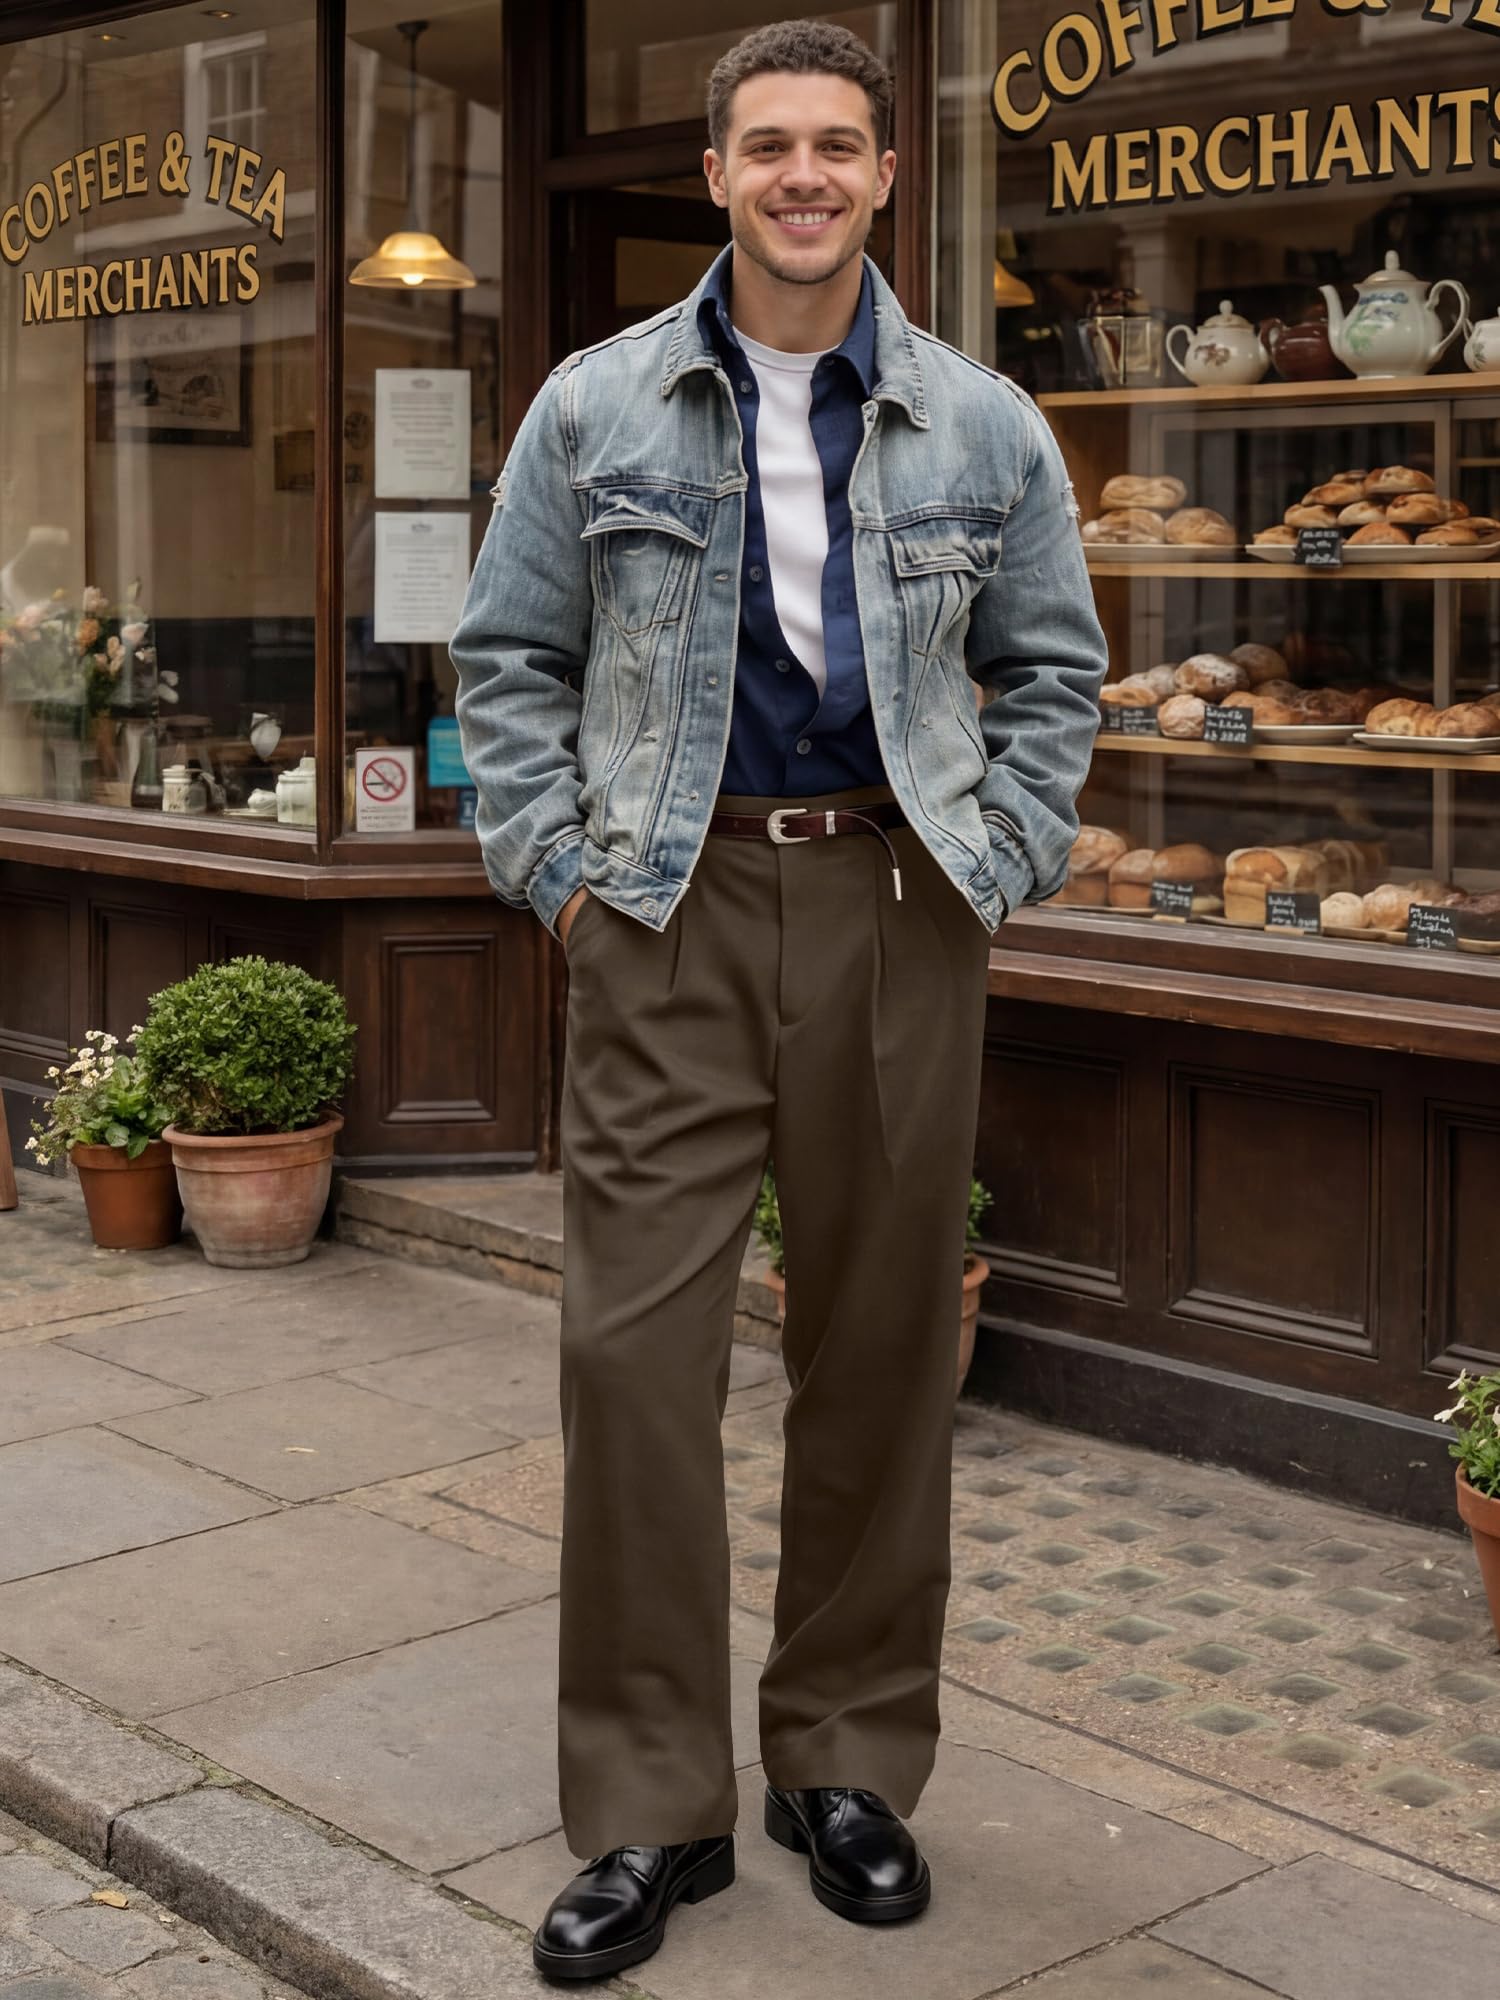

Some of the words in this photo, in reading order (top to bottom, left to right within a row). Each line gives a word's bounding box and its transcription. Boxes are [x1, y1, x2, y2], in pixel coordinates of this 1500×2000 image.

[0, 133, 148, 264] COFFEE
[158, 131, 191, 195] &
[205, 135, 287, 243] TEA
[1049, 86, 1500, 212] MERCHANT
[23, 244, 260, 325] MERCHANTS
